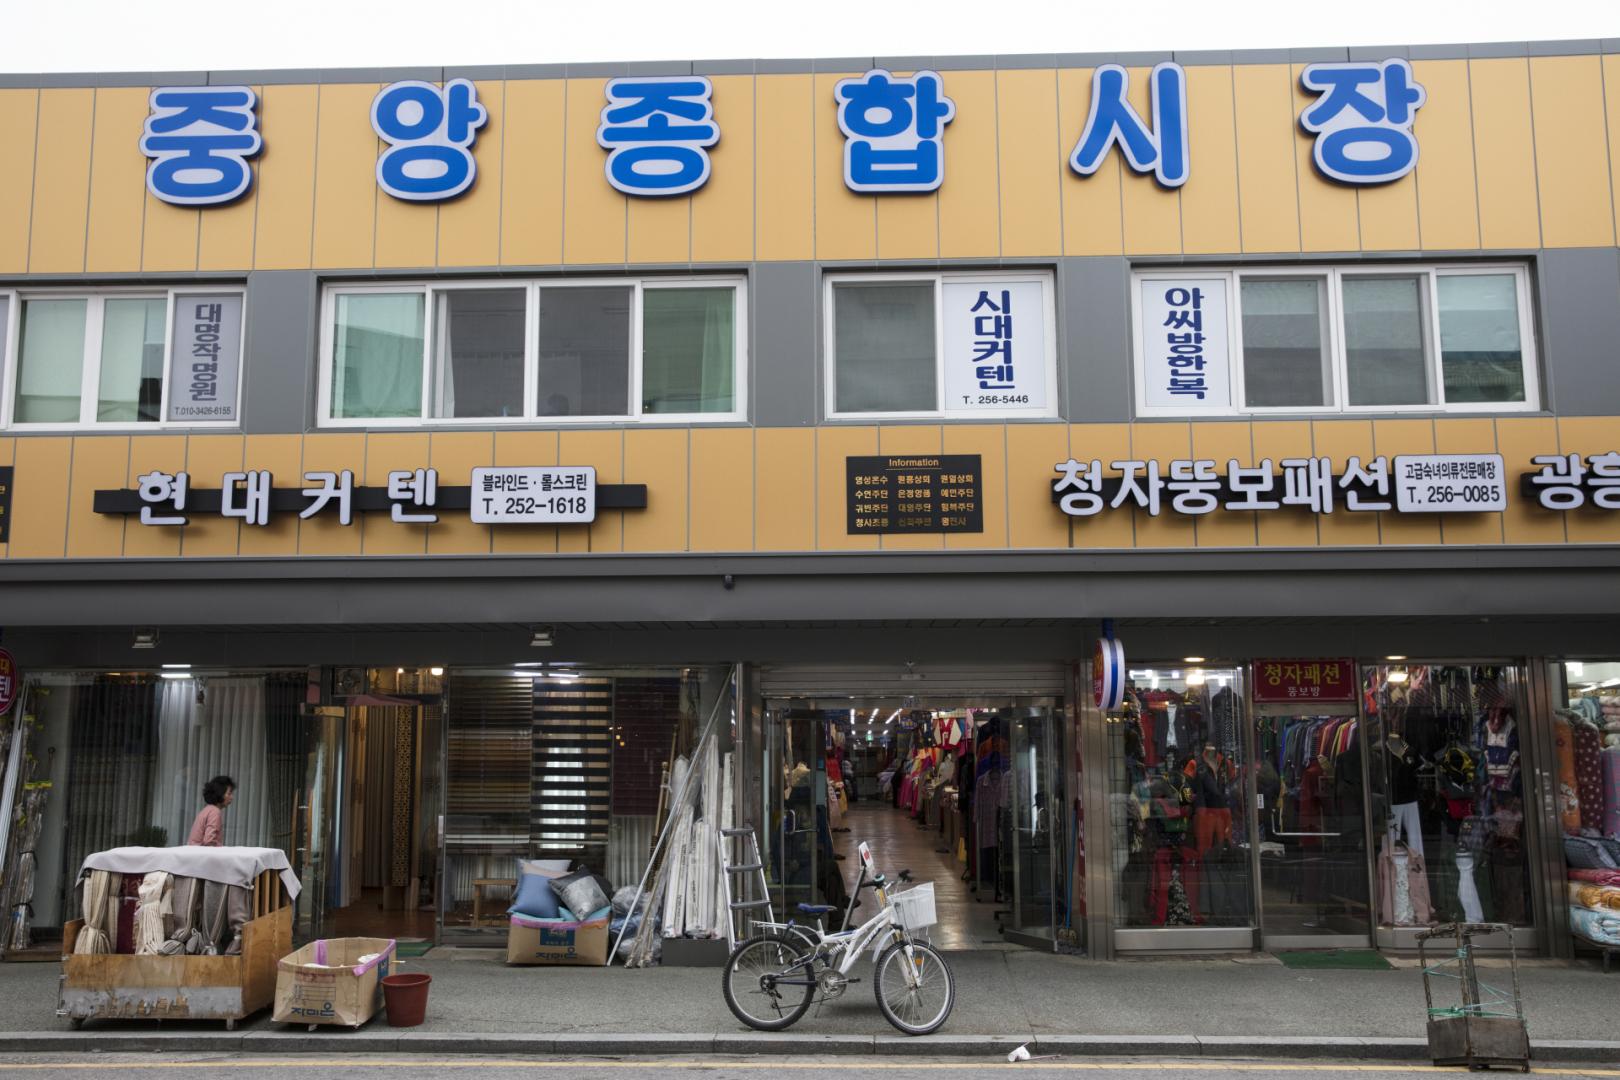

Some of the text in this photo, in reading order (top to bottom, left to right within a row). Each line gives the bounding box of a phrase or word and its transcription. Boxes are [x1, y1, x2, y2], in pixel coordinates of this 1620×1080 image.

[139, 58, 1426, 208] 중앙종합시장
[970, 289, 1016, 390] 시대커텐
[1163, 287, 1209, 400] 아씨방한복
[189, 303, 222, 402] 대명작명원
[978, 394, 1029, 405] 256-5446
[888, 458, 939, 467] Information
[1404, 461, 1496, 480] 고급숙녀의류전문매장
[482, 474, 529, 492] 블라인드
[541, 473, 587, 491] 롤스크린
[1053, 455, 1393, 516] 청자뚱보패션
[137, 467, 440, 526] 현대커텐
[1427, 485, 1500, 503] 256-0085
[505, 496, 588, 514] 252-1618
[1264, 663, 1340, 686] 청자패션
[1287, 686, 1321, 697] 뚱보방
